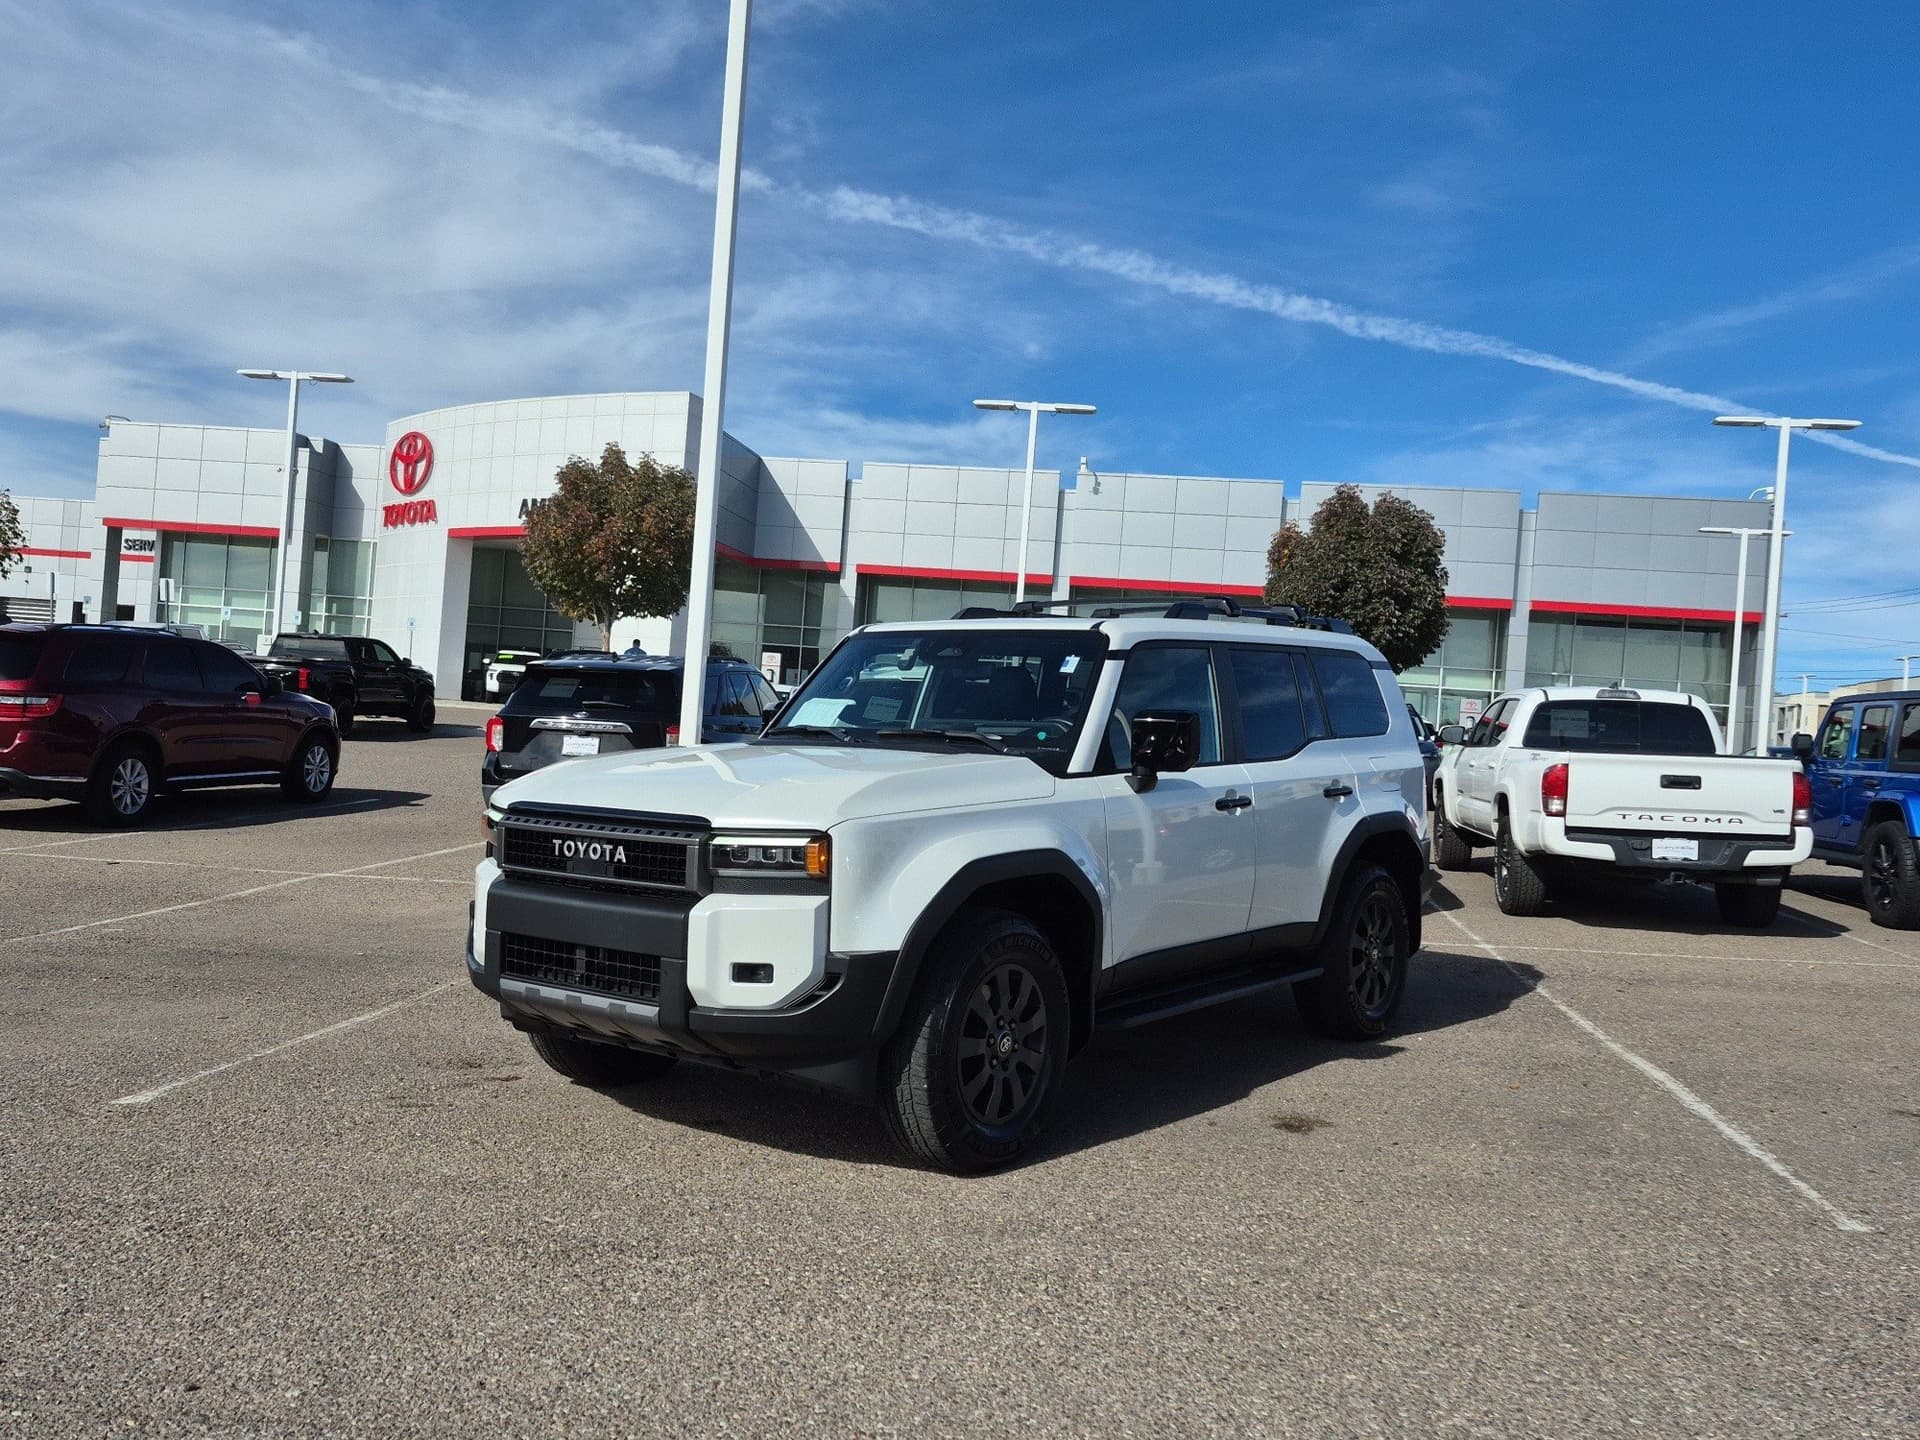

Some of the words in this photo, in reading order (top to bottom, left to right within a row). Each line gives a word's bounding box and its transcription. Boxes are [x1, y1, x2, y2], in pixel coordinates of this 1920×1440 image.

[383, 499, 438, 529] TOYOTA
[123, 538, 156, 552] SERV
[1616, 813, 1744, 825] TACOMA
[552, 839, 627, 864] TOYOTA
